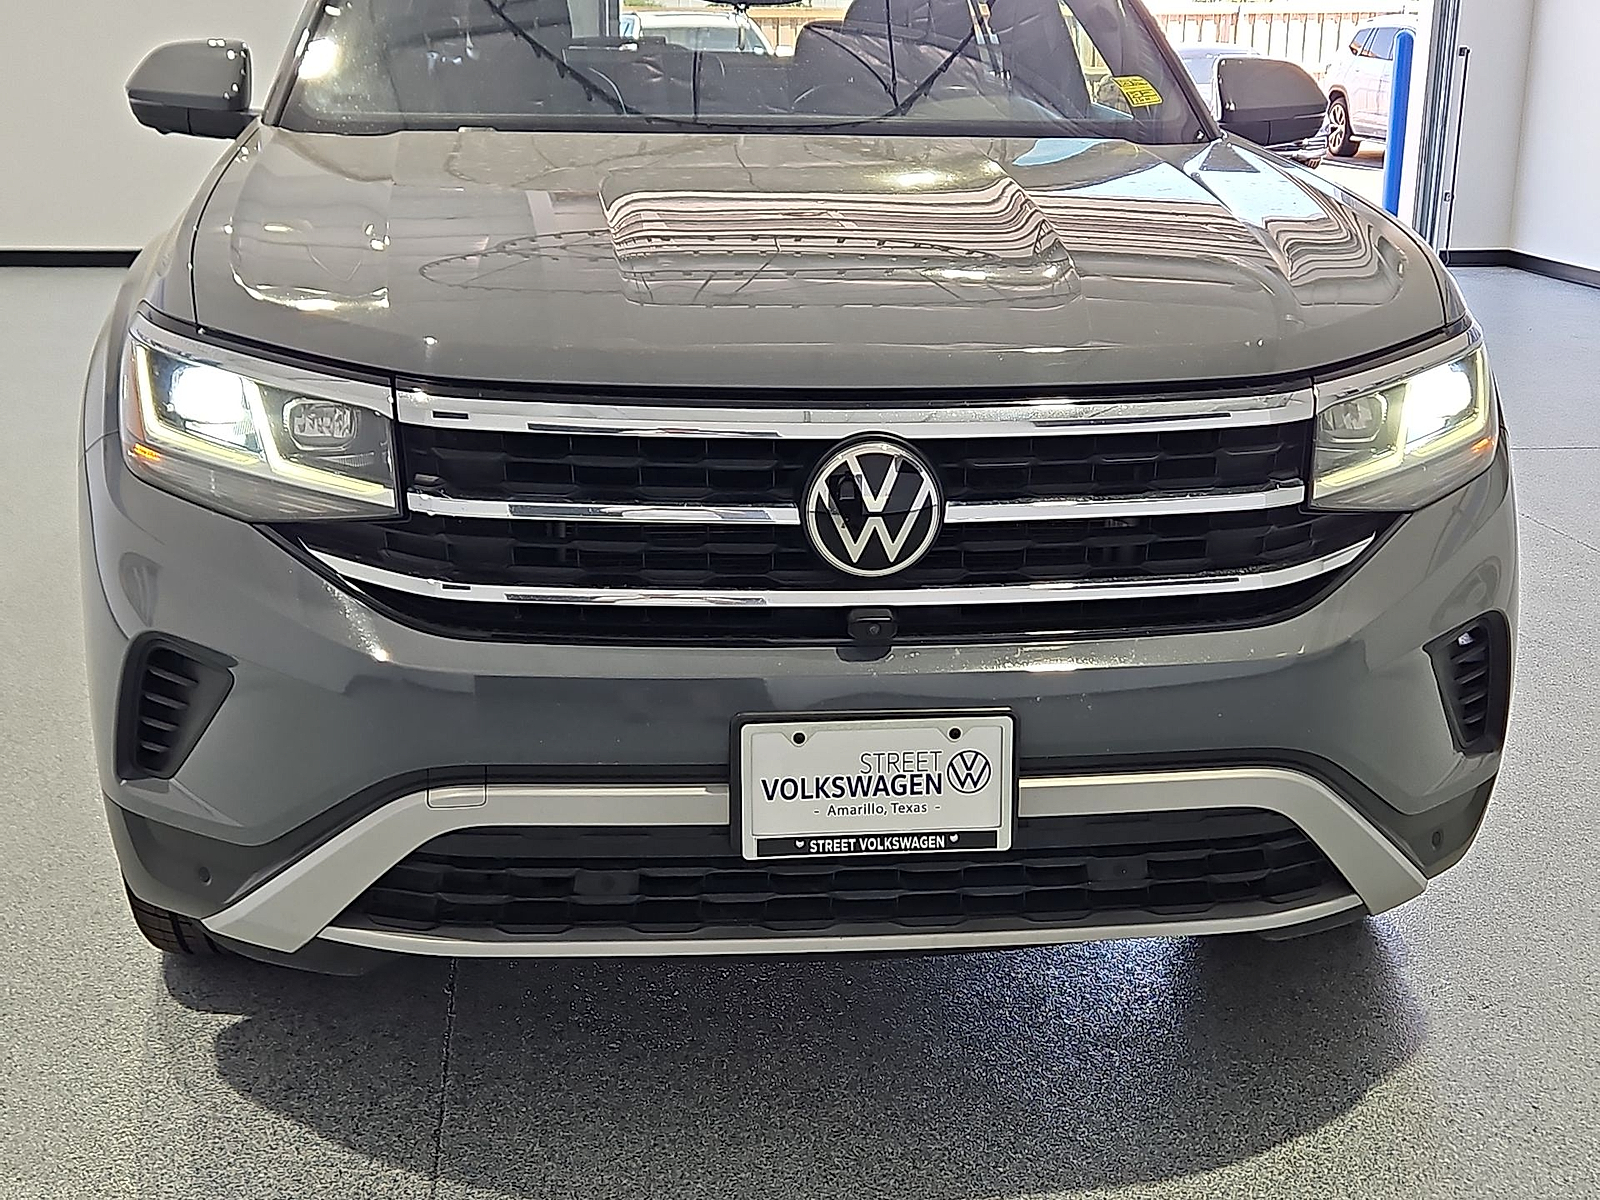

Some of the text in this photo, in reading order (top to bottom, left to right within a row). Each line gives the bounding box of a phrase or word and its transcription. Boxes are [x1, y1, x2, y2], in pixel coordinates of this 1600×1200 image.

[860, 751, 943, 774] STREET
[761, 773, 943, 801] VOLKSWAGEN
[827, 803, 888, 817] Amarillo,
[891, 802, 928, 815] Texas
[809, 835, 946, 853] STREET VOLKSWAGEN
